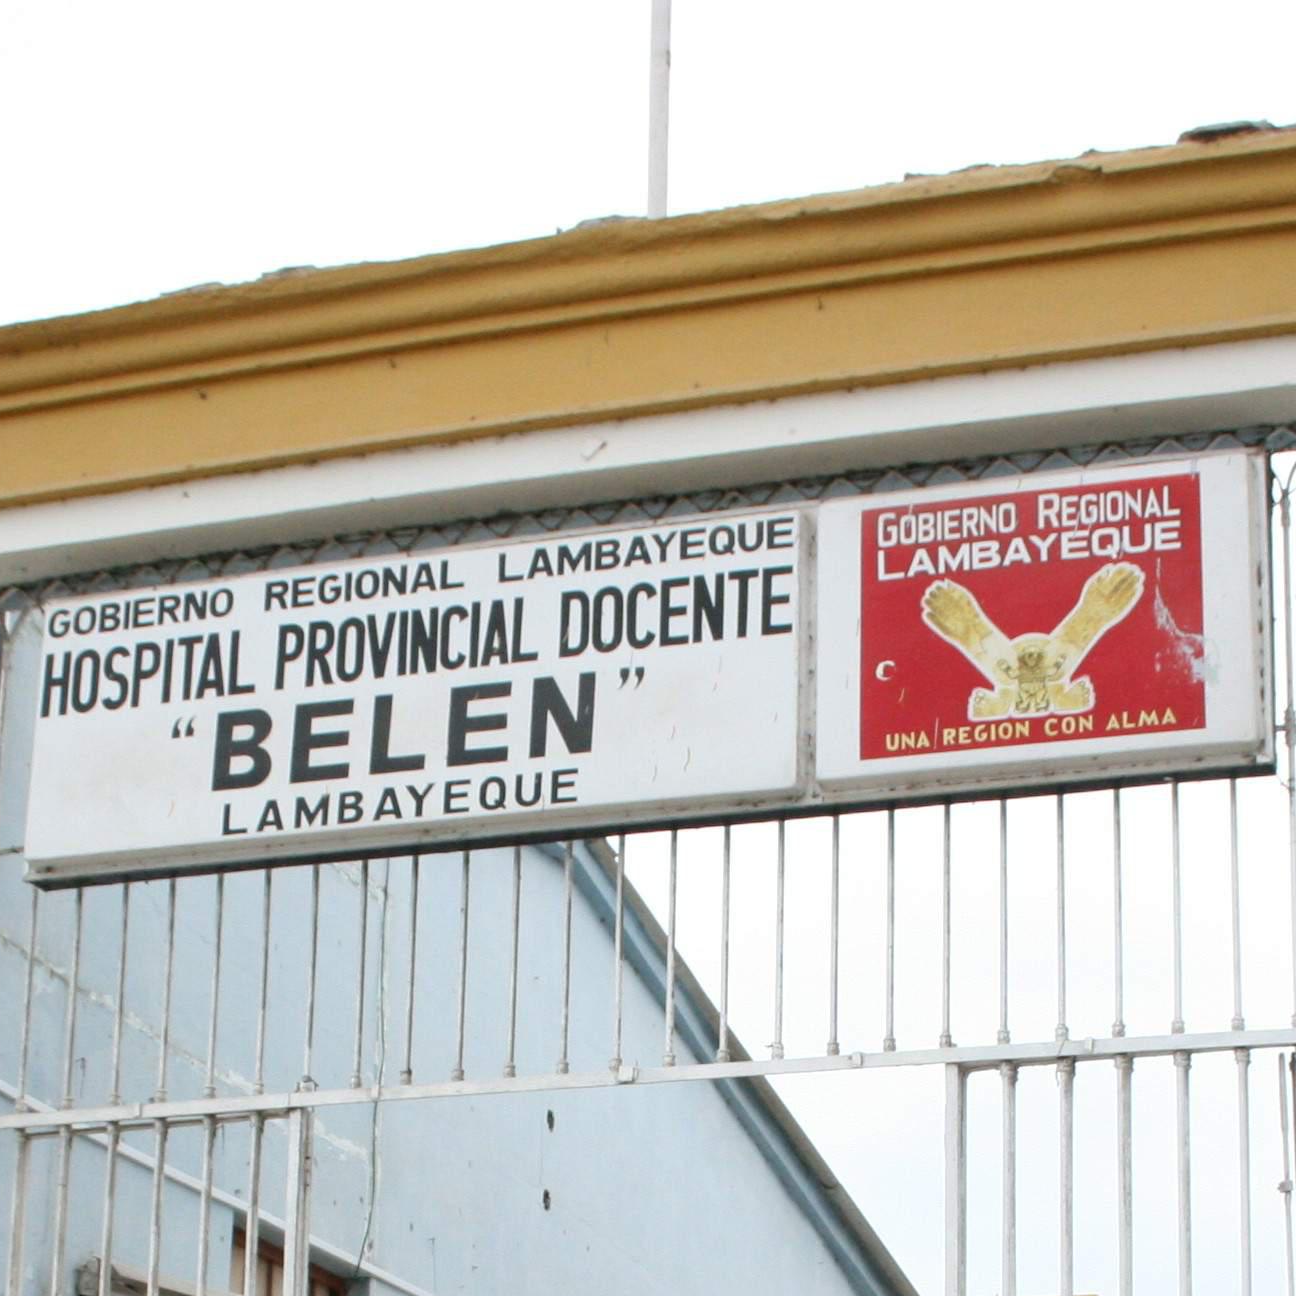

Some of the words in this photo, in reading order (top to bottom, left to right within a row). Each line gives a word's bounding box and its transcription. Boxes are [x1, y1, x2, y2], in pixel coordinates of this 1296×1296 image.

[877, 501, 1017, 549] GOBIERNO
[1037, 484, 1181, 530] REGIONAL
[47, 588, 235, 639] GOBIERNO
[263, 560, 464, 614] REGIONAL
[499, 517, 796, 584] LAMBAYEQUE
[877, 520, 1182, 582] LAMBAYEQUE
[40, 629, 256, 719] HOSPITAL
[275, 599, 539, 691] PROVINCIAL
[558, 564, 794, 660] DOCENTE
[884, 728, 931, 753] UNA
[941, 717, 1031, 747] REGION
[1043, 711, 1095, 739] CON
[1105, 707, 1178, 733] ALMA
[221, 768, 579, 837] LAMBAYEQUE
